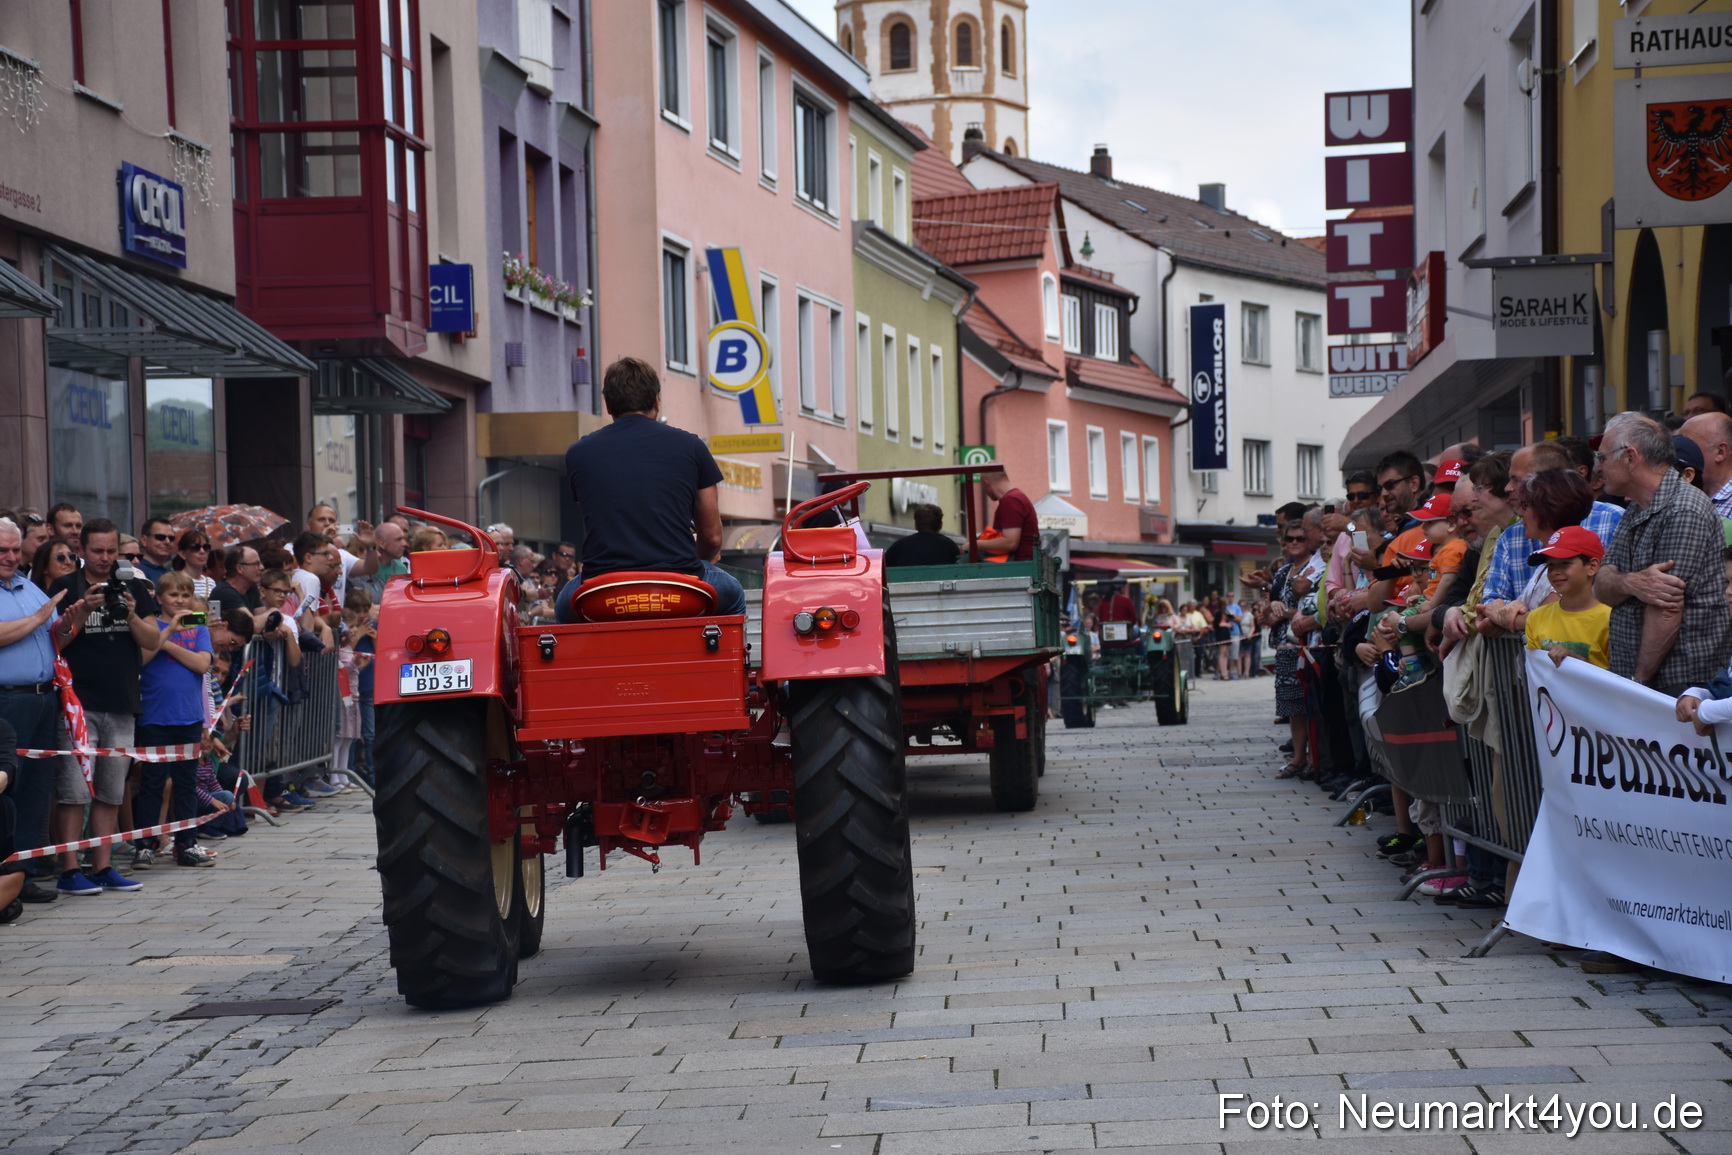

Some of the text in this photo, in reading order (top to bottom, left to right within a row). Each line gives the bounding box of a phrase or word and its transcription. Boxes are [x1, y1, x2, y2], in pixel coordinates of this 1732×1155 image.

[1630, 24, 1732, 53] RATHAUS
[36, 194, 41, 213] 2
[132, 173, 186, 238] CECIL
[1329, 93, 1390, 329] WITT
[1500, 293, 1588, 318] SARAH K
[1500, 316, 1589, 328] MODE & LIFESTYLE
[715, 338, 748, 374] B
[1330, 344, 1408, 373] WITT
[1213, 317, 1224, 456] TOM TAILOR
[68, 383, 112, 430] CECIL
[161, 404, 199, 446] CECIL
[326, 441, 353, 475] CECIL
[605, 593, 682, 607] PORSCHE
[614, 603, 671, 615] DIESEL
[414, 663, 437, 678] NM
[1574, 814, 1602, 840] DAS
